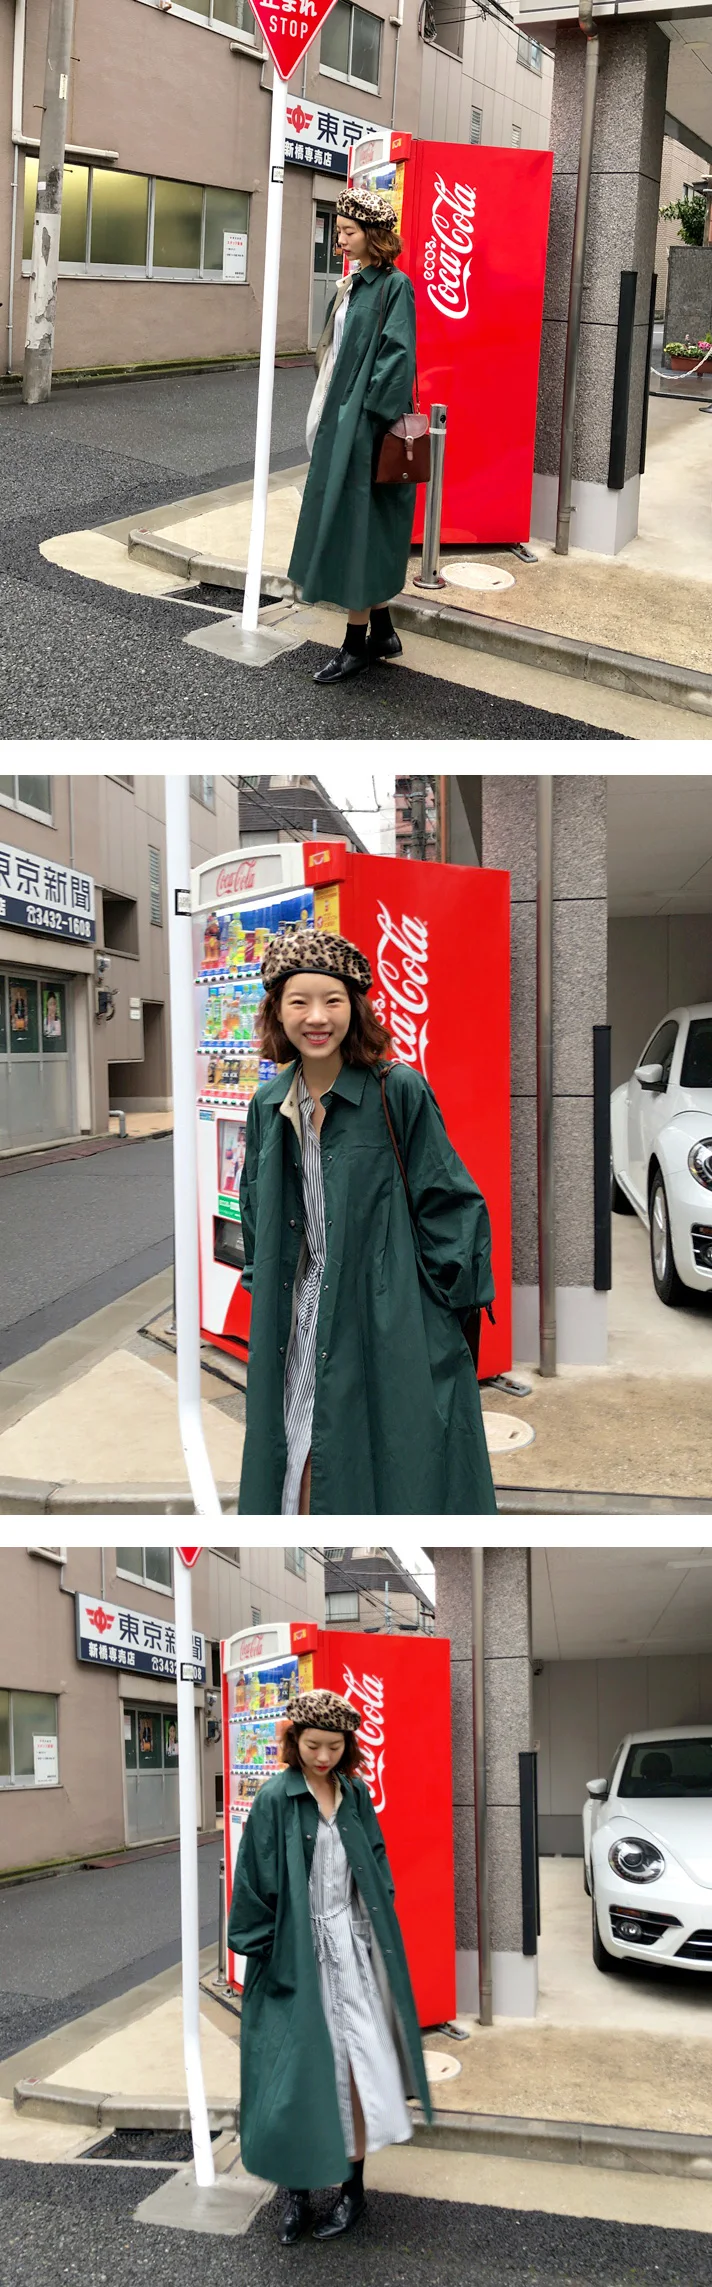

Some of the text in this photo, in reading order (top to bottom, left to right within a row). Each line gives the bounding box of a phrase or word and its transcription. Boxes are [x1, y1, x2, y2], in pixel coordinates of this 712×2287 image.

[269, 15, 309, 39] STOP
[317, 111, 377, 148] 東京
[285, 140, 333, 167] 新橋専売店
[427, 171, 477, 319] Coca-Cola
[36, 906, 92, 938] 3432-1608
[87, 1640, 136, 1667] 新橋専売店
